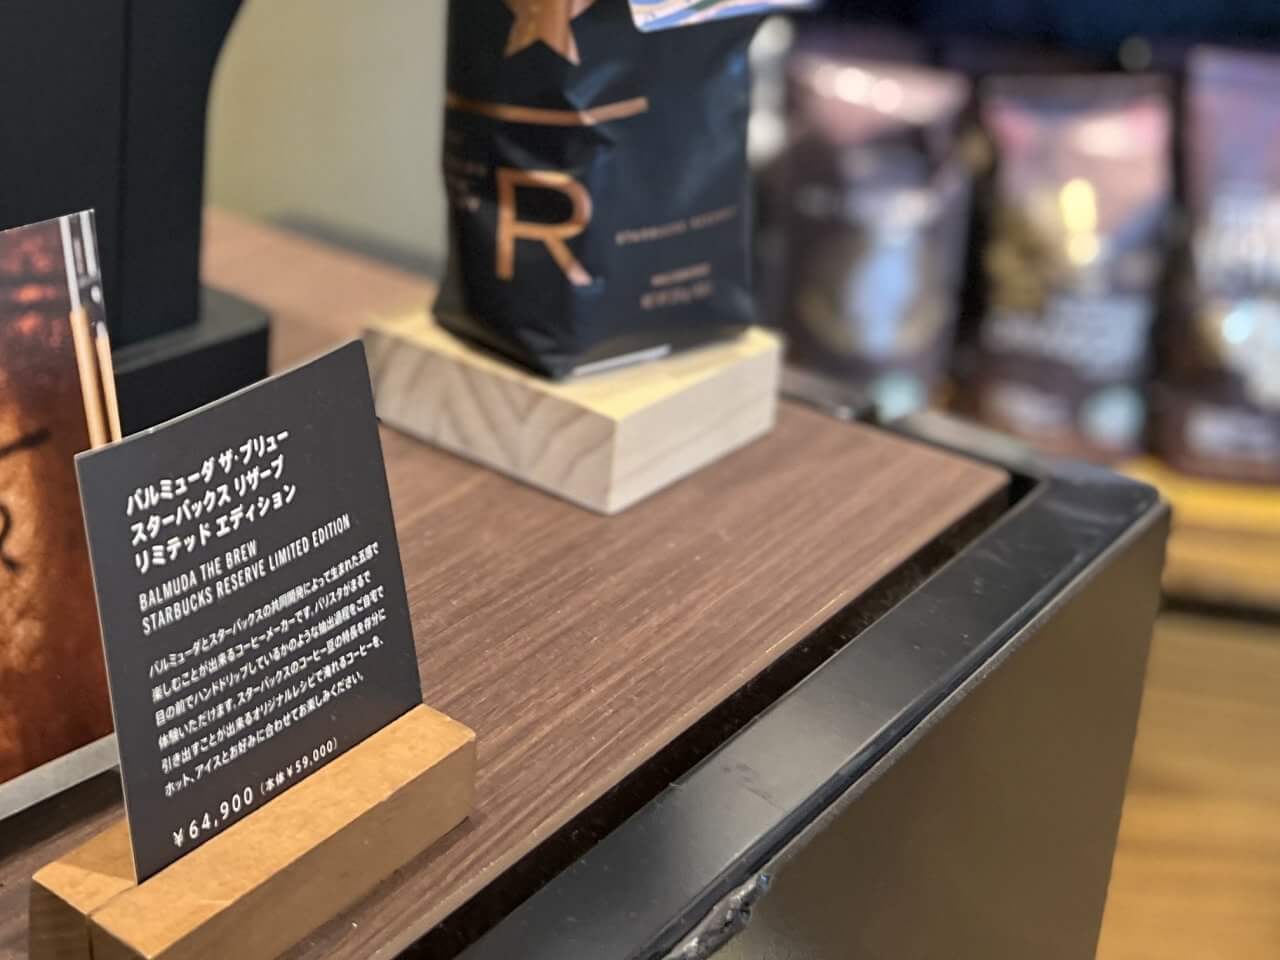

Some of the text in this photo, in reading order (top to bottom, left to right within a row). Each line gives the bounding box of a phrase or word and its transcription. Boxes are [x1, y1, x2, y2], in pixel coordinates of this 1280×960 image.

[496, 167, 593, 286] R
[126, 456, 215, 516] バルミューダ
[130, 453, 284, 546] スターバックス リザーブ
[135, 484, 296, 574] リミテッド エディション
[138, 539, 258, 612] BALMUDA THE BREW
[142, 513, 351, 636] STARBUCKS RESERVE LIMITED EDITION
